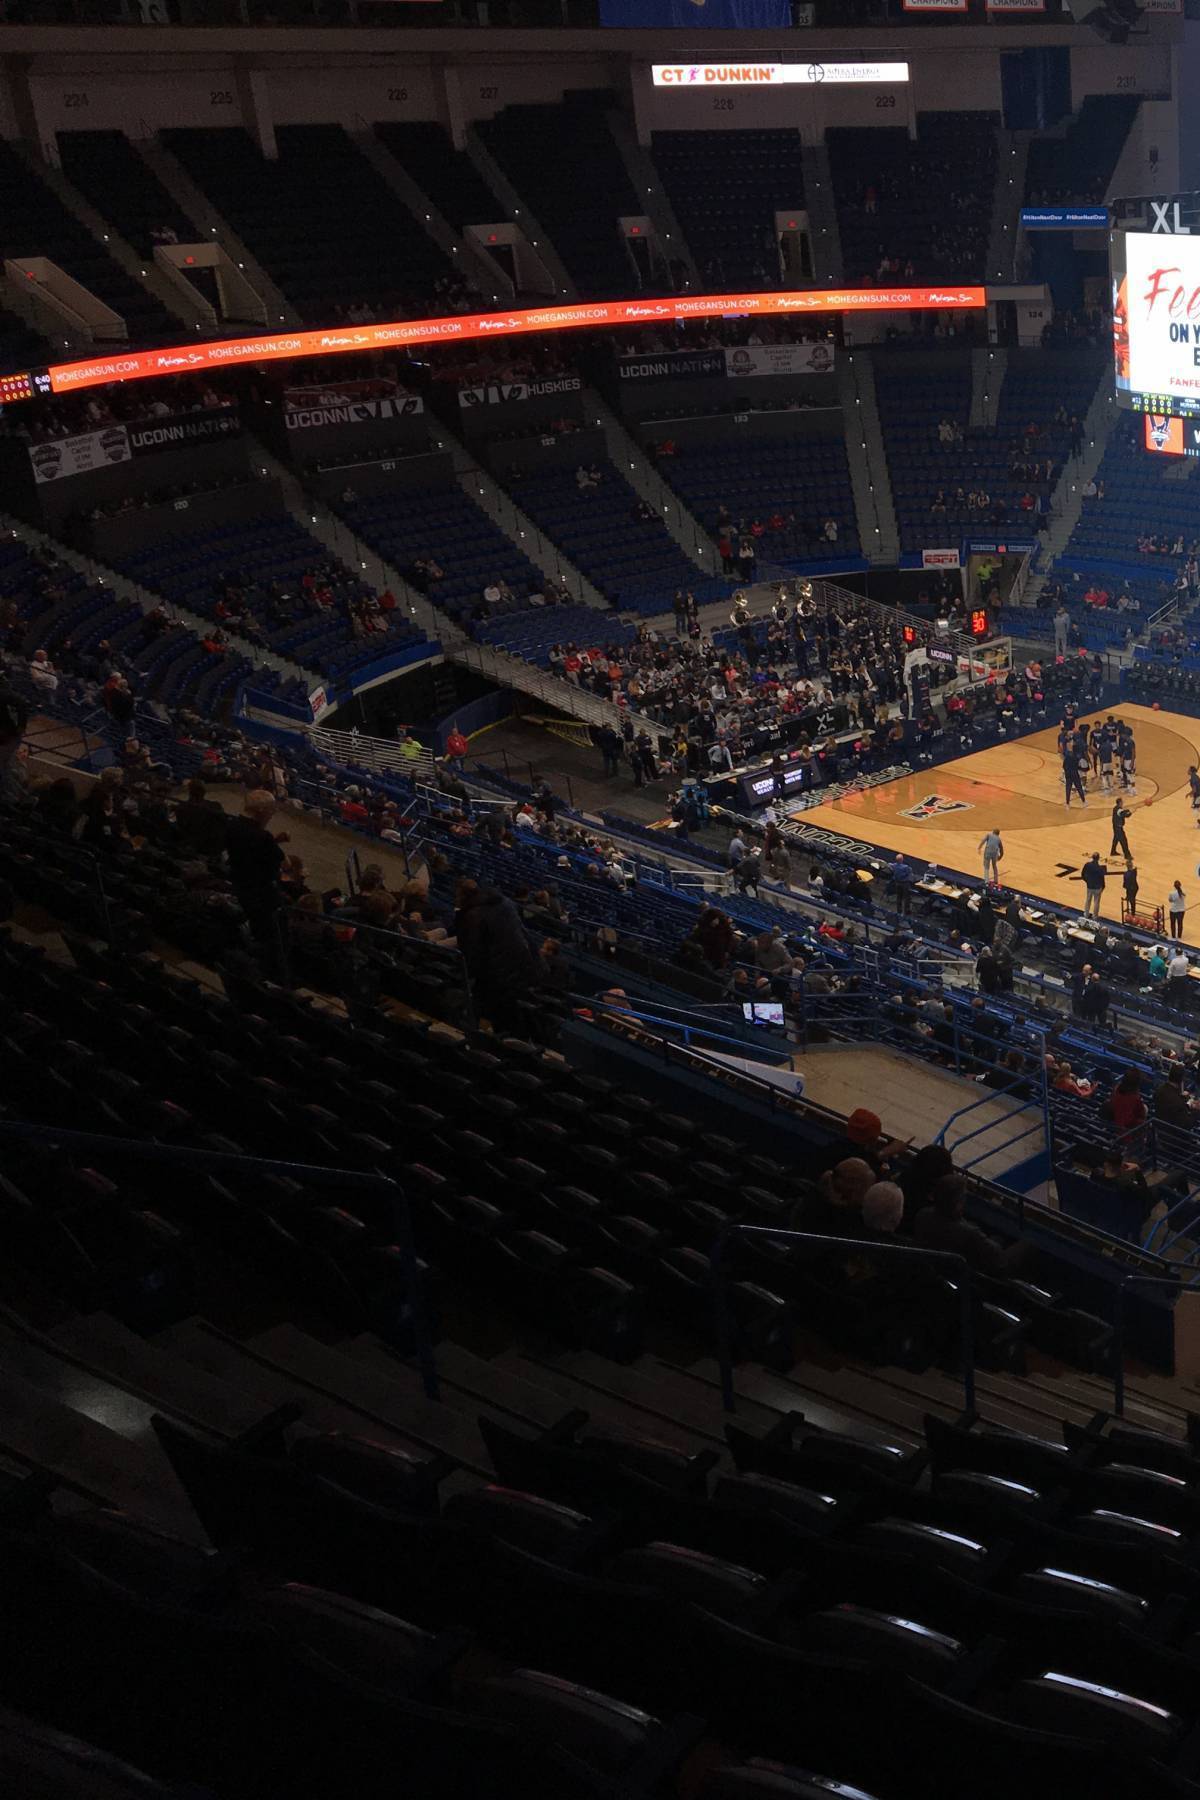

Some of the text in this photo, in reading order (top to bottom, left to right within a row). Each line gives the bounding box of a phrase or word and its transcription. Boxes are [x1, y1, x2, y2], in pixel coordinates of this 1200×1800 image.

[661, 67, 775, 82] CT DUNKIN'
[210, 91, 233, 105] 225
[480, 87, 498, 100] 227
[875, 96, 896, 108] 229
[1150, 202, 1192, 234] XL
[1169, 322, 1189, 344] ON
[56, 360, 140, 383] MOHEGANSUN.COM
[208, 340, 301, 359] MOHEGANSUN.COM
[374, 323, 462, 340] MOHEGANSUN.COM
[526, 308, 608, 325] MOHEGANSUN.COM
[675, 299, 760, 312] MOHEGANSUN.COM
[620, 363, 668, 378] UCONN
[526, 378, 581, 398] HUSKIES
[284, 406, 348, 430] UCONN
[132, 426, 184, 448] UCONN
[381, 462, 396, 472] 121
[924, 554, 958, 564] ESPN
[930, 650, 952, 660] UCONN
[816, 712, 834, 731] XL
